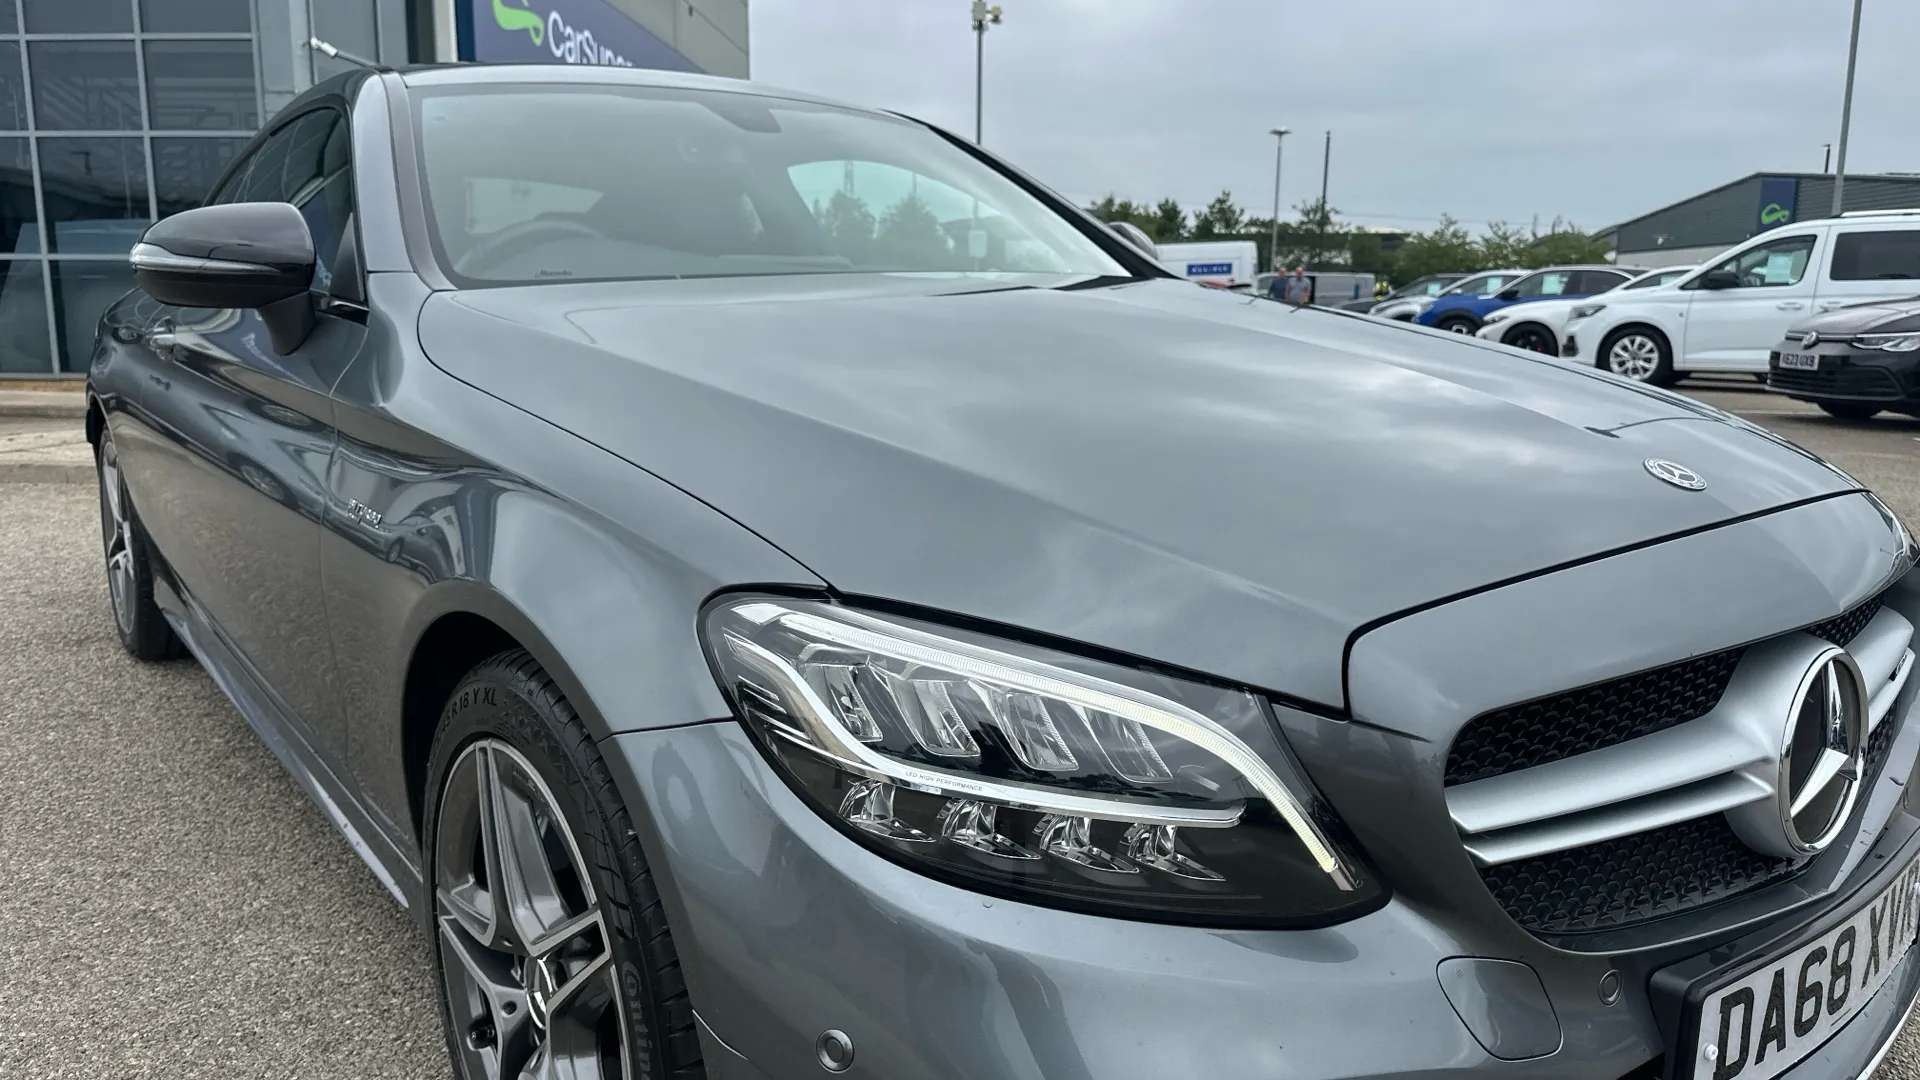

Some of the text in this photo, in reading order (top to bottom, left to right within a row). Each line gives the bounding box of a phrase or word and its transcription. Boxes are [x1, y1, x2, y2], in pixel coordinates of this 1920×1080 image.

[482, 687, 497, 706] XL
[905, 770, 983, 791] LED HIGH PERFORMANCE
[1712, 924, 1857, 1080] DA68
